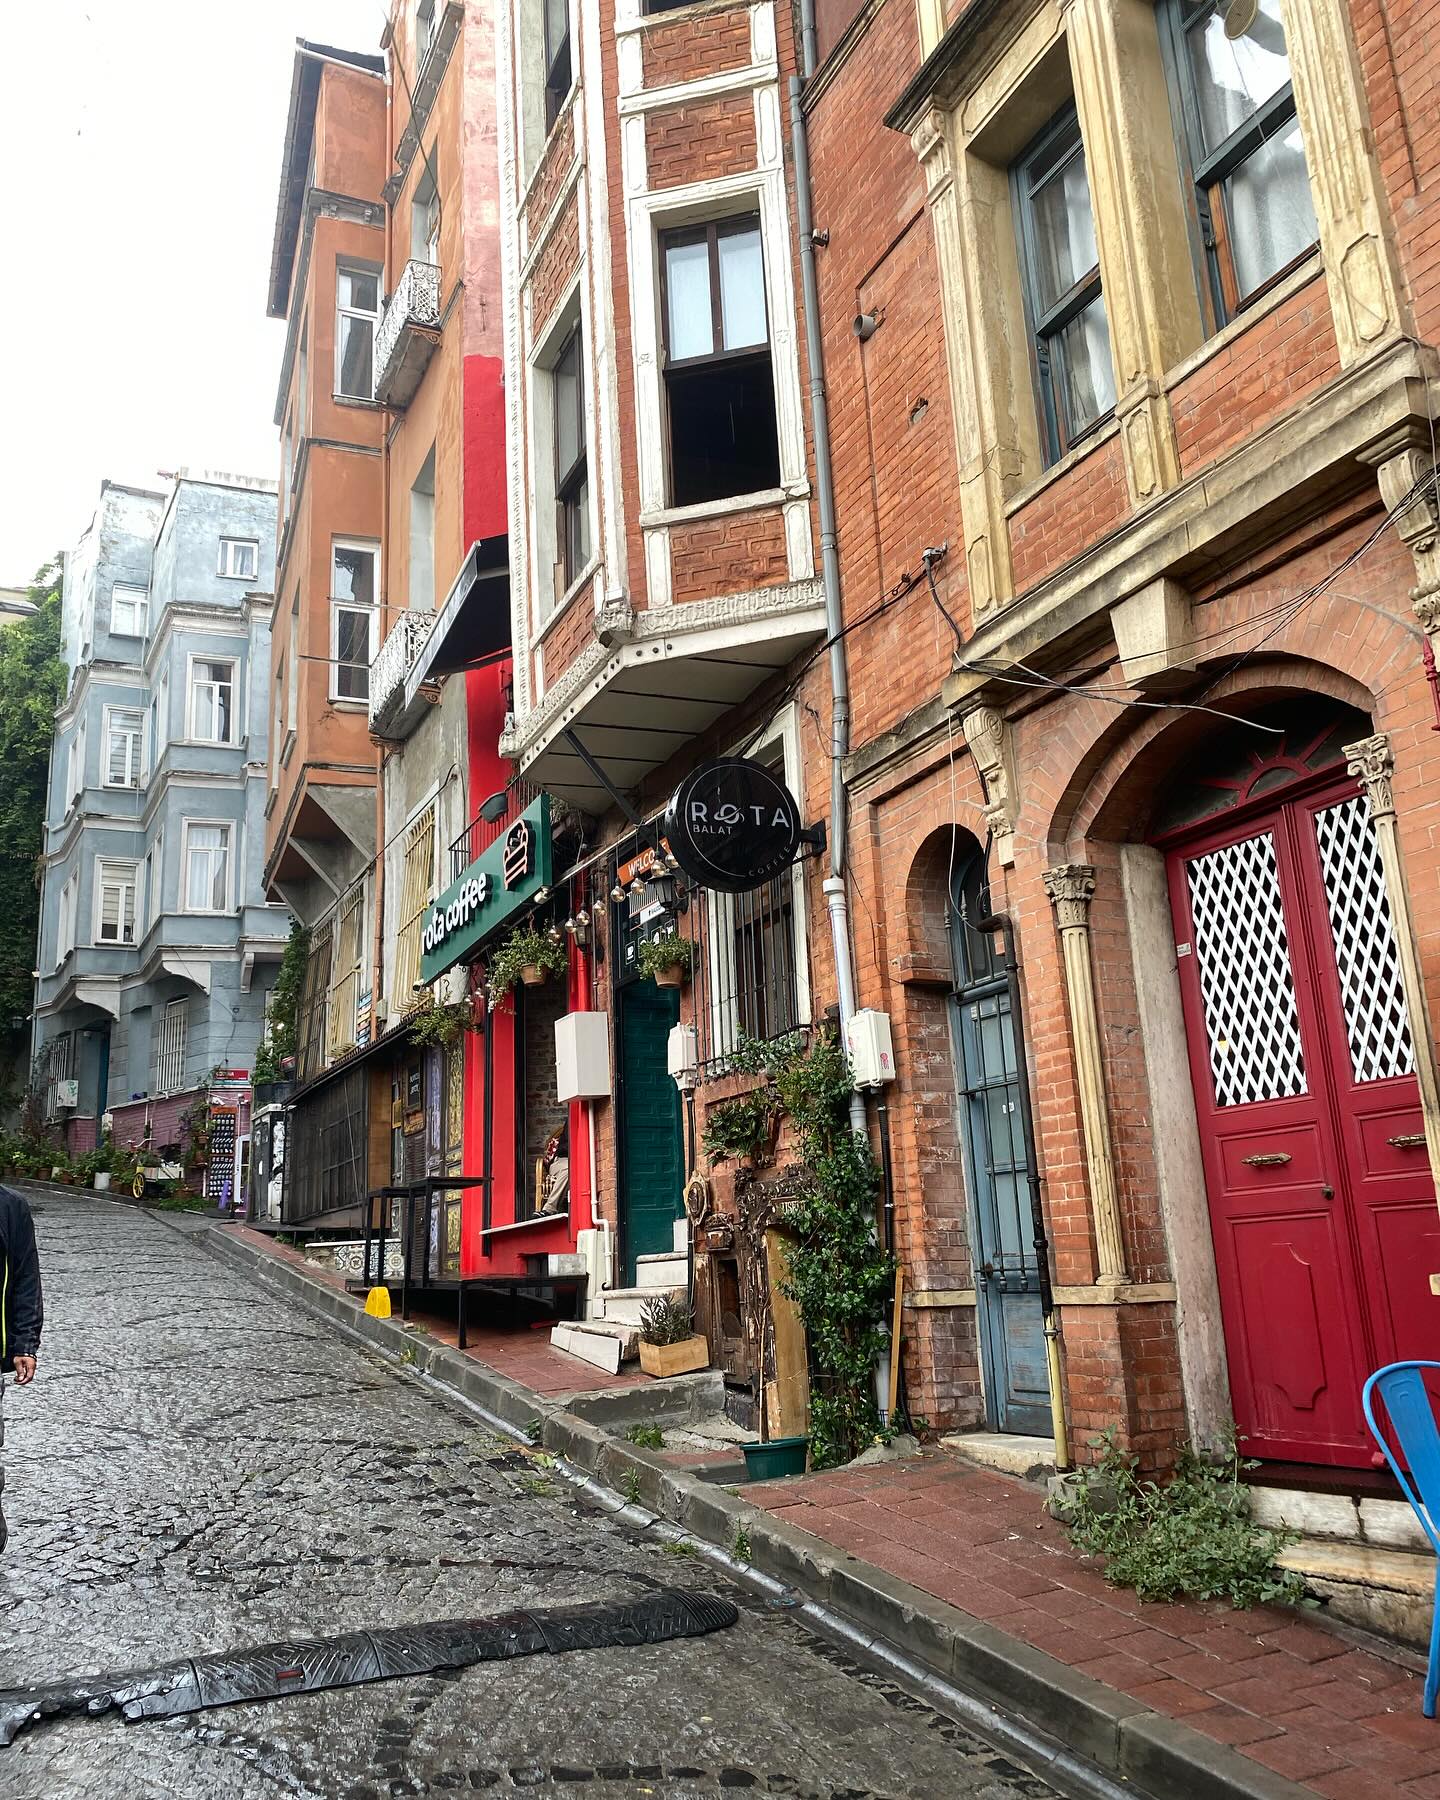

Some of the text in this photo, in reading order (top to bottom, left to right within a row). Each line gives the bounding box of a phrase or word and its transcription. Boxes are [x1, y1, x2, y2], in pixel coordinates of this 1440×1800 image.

[690, 801, 790, 828] ROTA
[692, 824, 733, 835] BALAT
[748, 846, 791, 876] COFFEE
[421, 872, 487, 955] rota coffee
